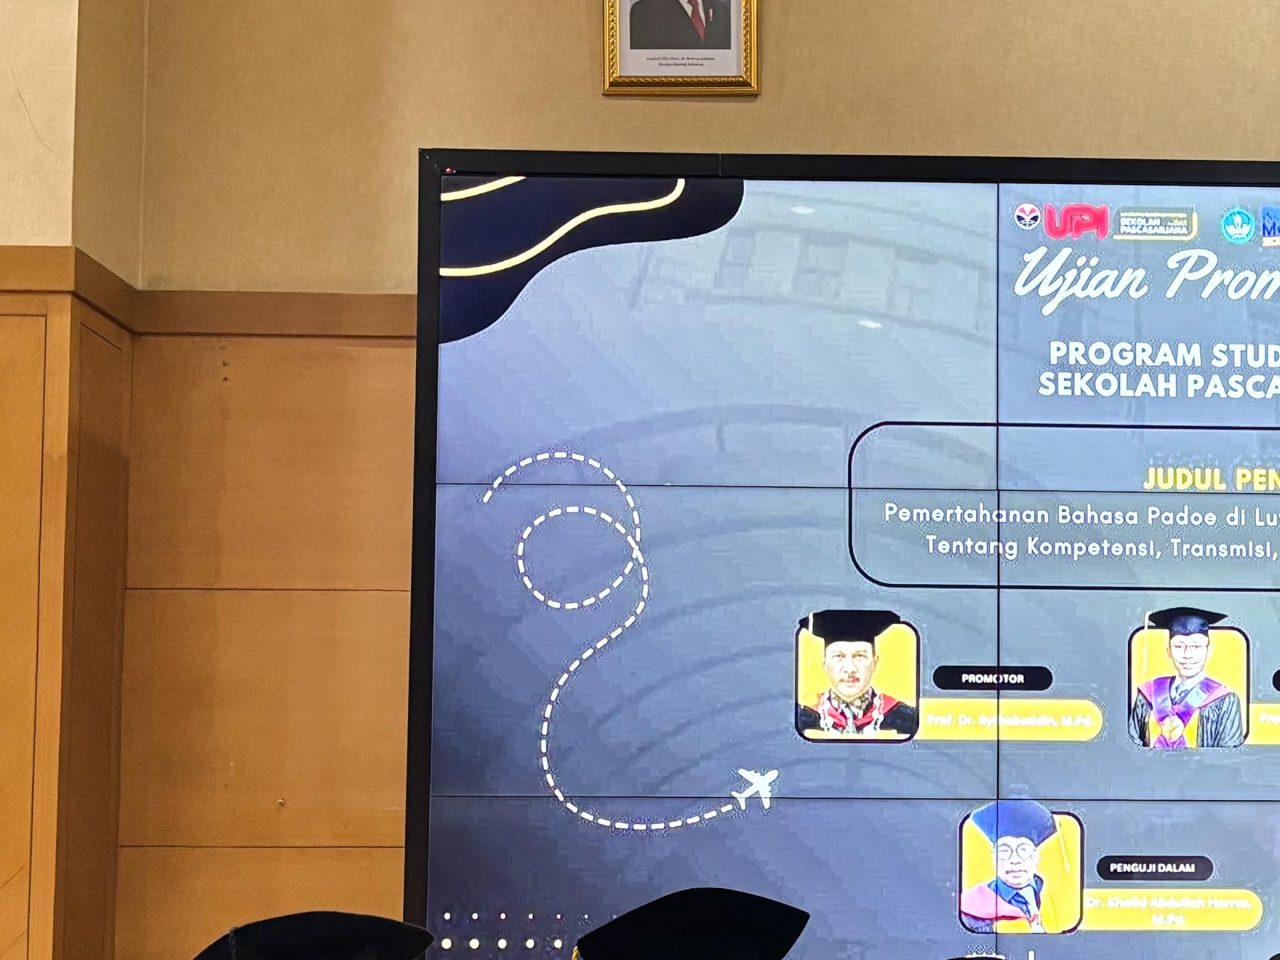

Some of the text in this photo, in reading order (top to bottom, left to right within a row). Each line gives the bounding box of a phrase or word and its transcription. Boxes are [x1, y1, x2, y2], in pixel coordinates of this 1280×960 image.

[1044, 204, 1110, 240] UPI
[1015, 246, 1149, 316] Ujian
[1049, 341, 1202, 368] PROGRAM
[1038, 372, 1177, 397] SEKOLAH
[1143, 468, 1226, 490] JUDUL
[885, 502, 1049, 523] Pemertahanan
[1059, 505, 1138, 525] Bahasa
[1148, 506, 1216, 526] Padoe
[1226, 505, 1246, 527] di
[926, 535, 1018, 560] Tentang
[1028, 537, 1162, 561] Kompetensi,
[1171, 537, 1278, 561] Transmisi,
[961, 673, 1025, 684] PROMOTOR
[1109, 863, 1196, 873] PENGUJI DALAM
